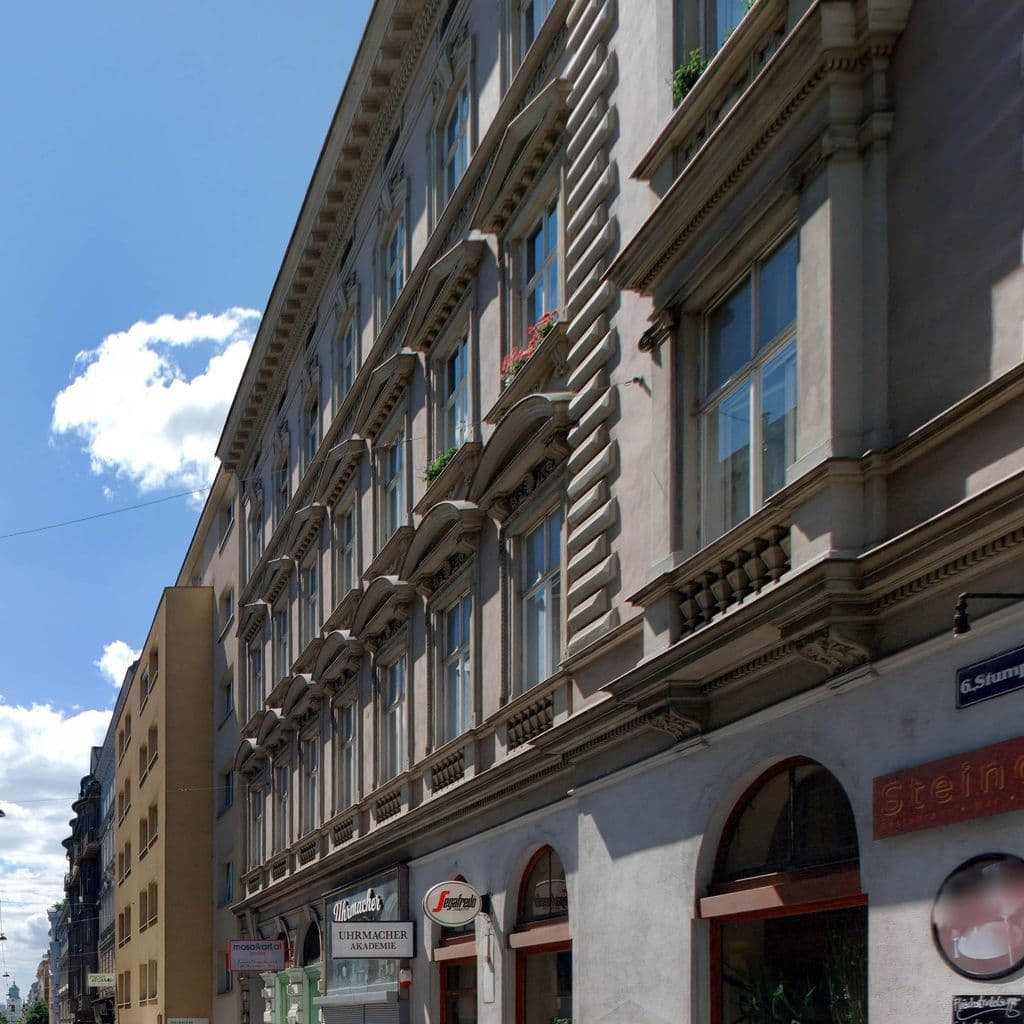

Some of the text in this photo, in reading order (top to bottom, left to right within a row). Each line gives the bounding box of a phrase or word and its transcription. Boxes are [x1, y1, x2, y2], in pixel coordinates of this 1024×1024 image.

[333, 888, 382, 921] Uhrmacher
[432, 890, 476, 912] Segafredo
[339, 931, 408, 940] UHRMACHER
[350, 942, 397, 950] AKADEMIE
